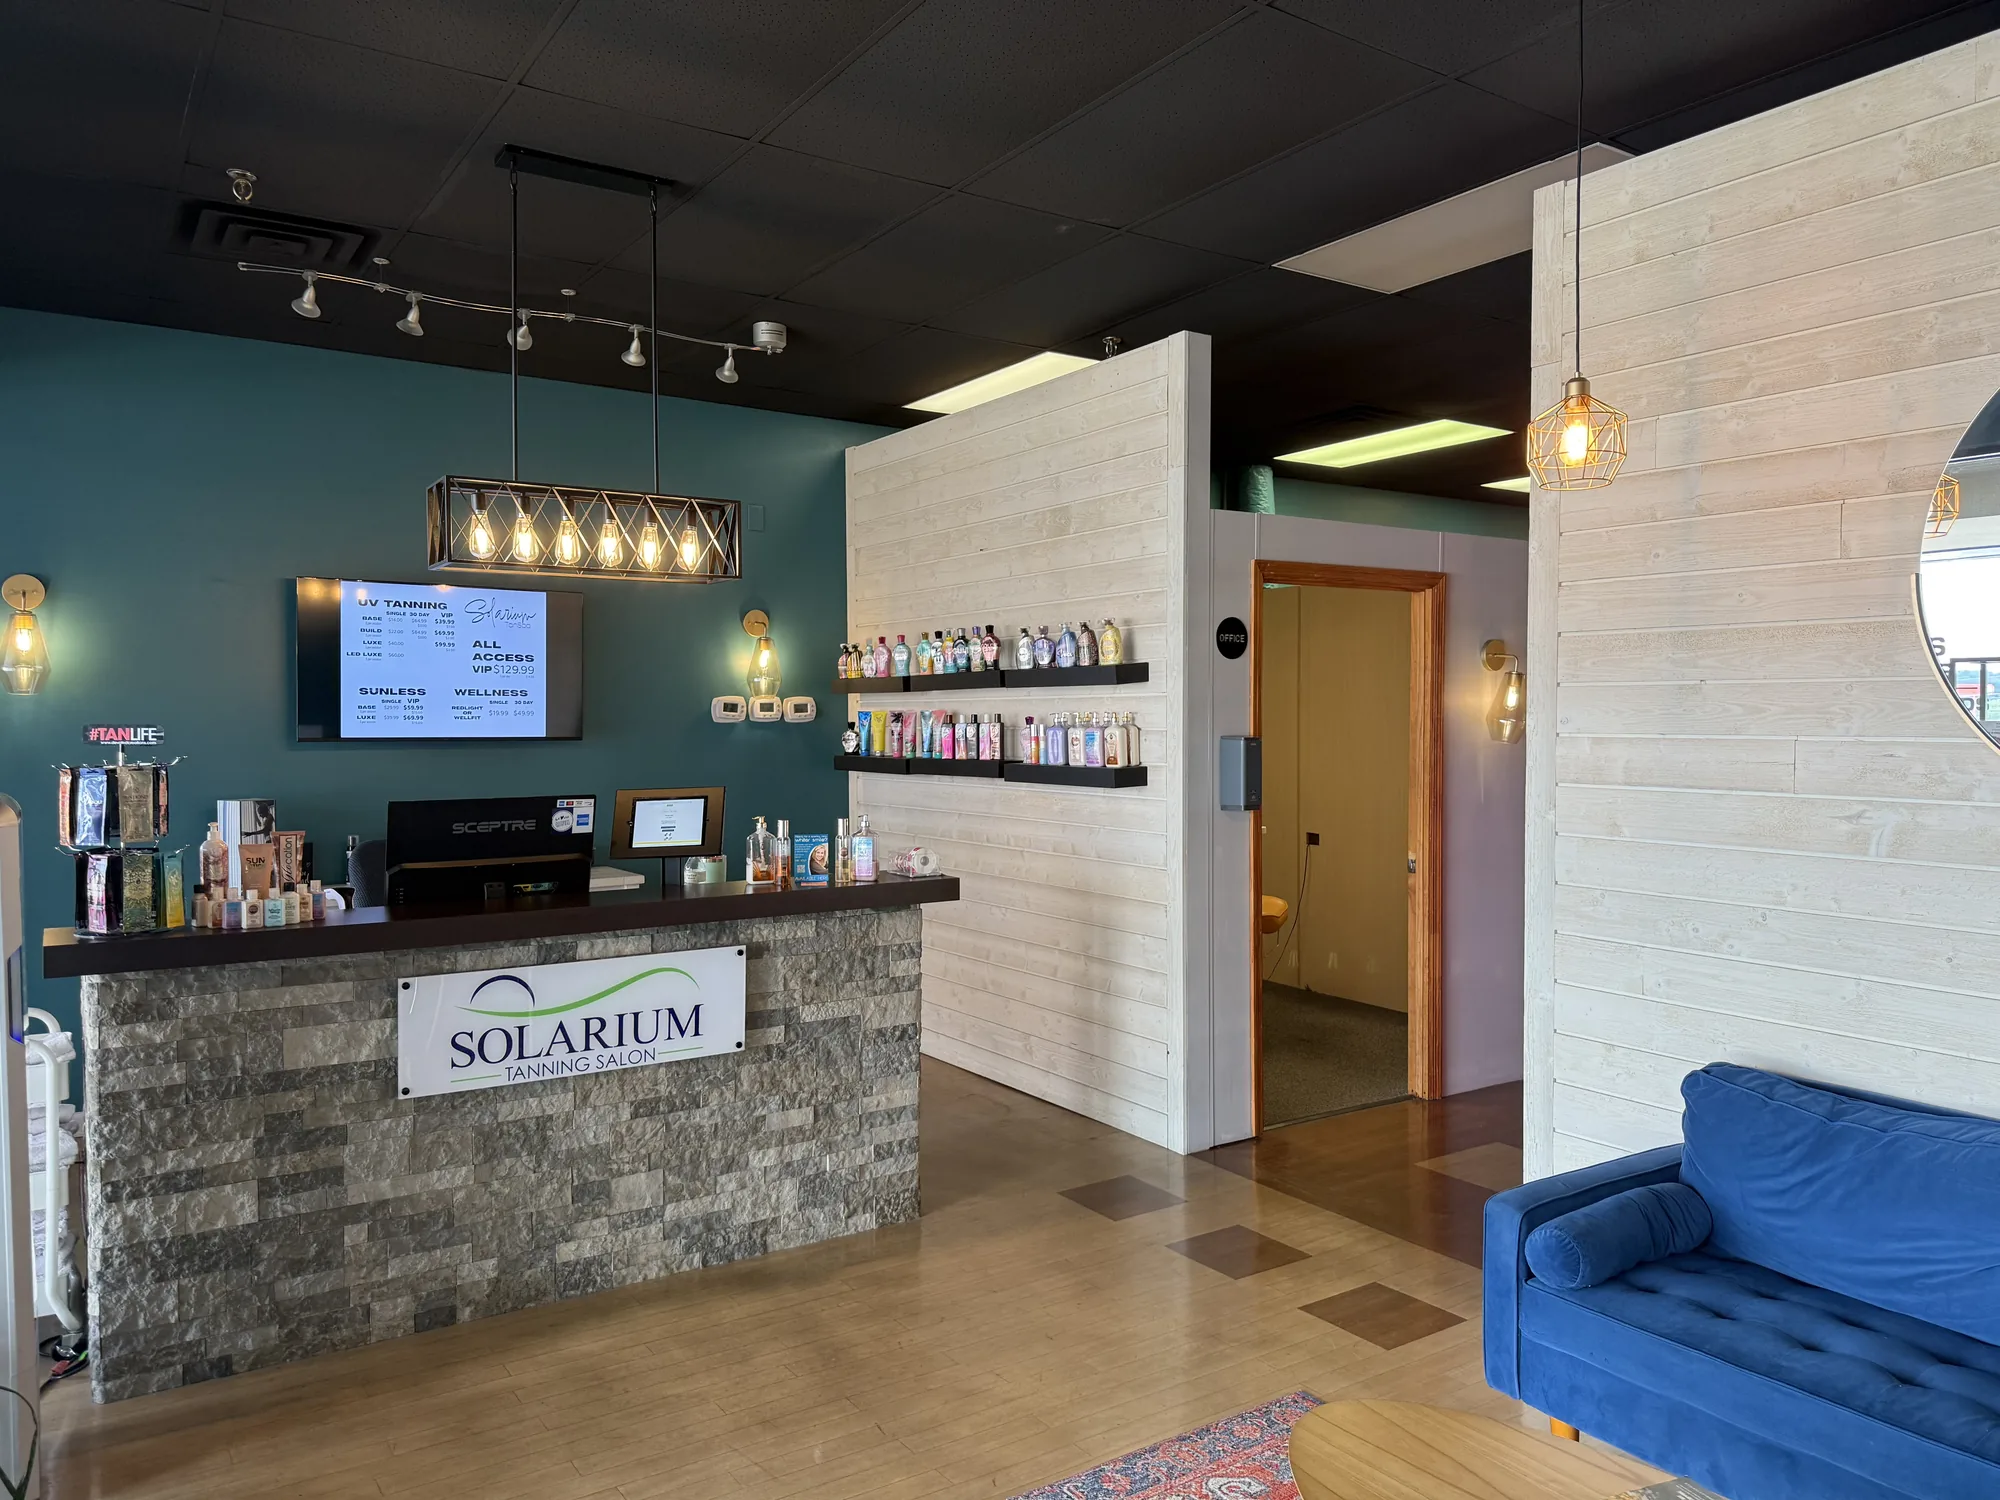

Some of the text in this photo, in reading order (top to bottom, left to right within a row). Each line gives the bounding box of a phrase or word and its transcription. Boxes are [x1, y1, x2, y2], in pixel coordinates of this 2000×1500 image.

[384, 600, 448, 610] TANNING
[1219, 633, 1246, 643] OFFICE
[472, 640, 501, 648] ALL
[472, 653, 535, 662] ACCESS
[472, 664, 535, 675] VIP $129.99
[359, 687, 426, 696] SUNLESS
[454, 688, 528, 696] WELLNESS
[89, 727, 158, 741] #TANLIFE
[452, 819, 536, 834] SCEPTRE
[245, 856, 265, 864] SUN
[450, 1003, 704, 1070] SOLARIUM
[505, 1048, 657, 1082] TANNING SALON
